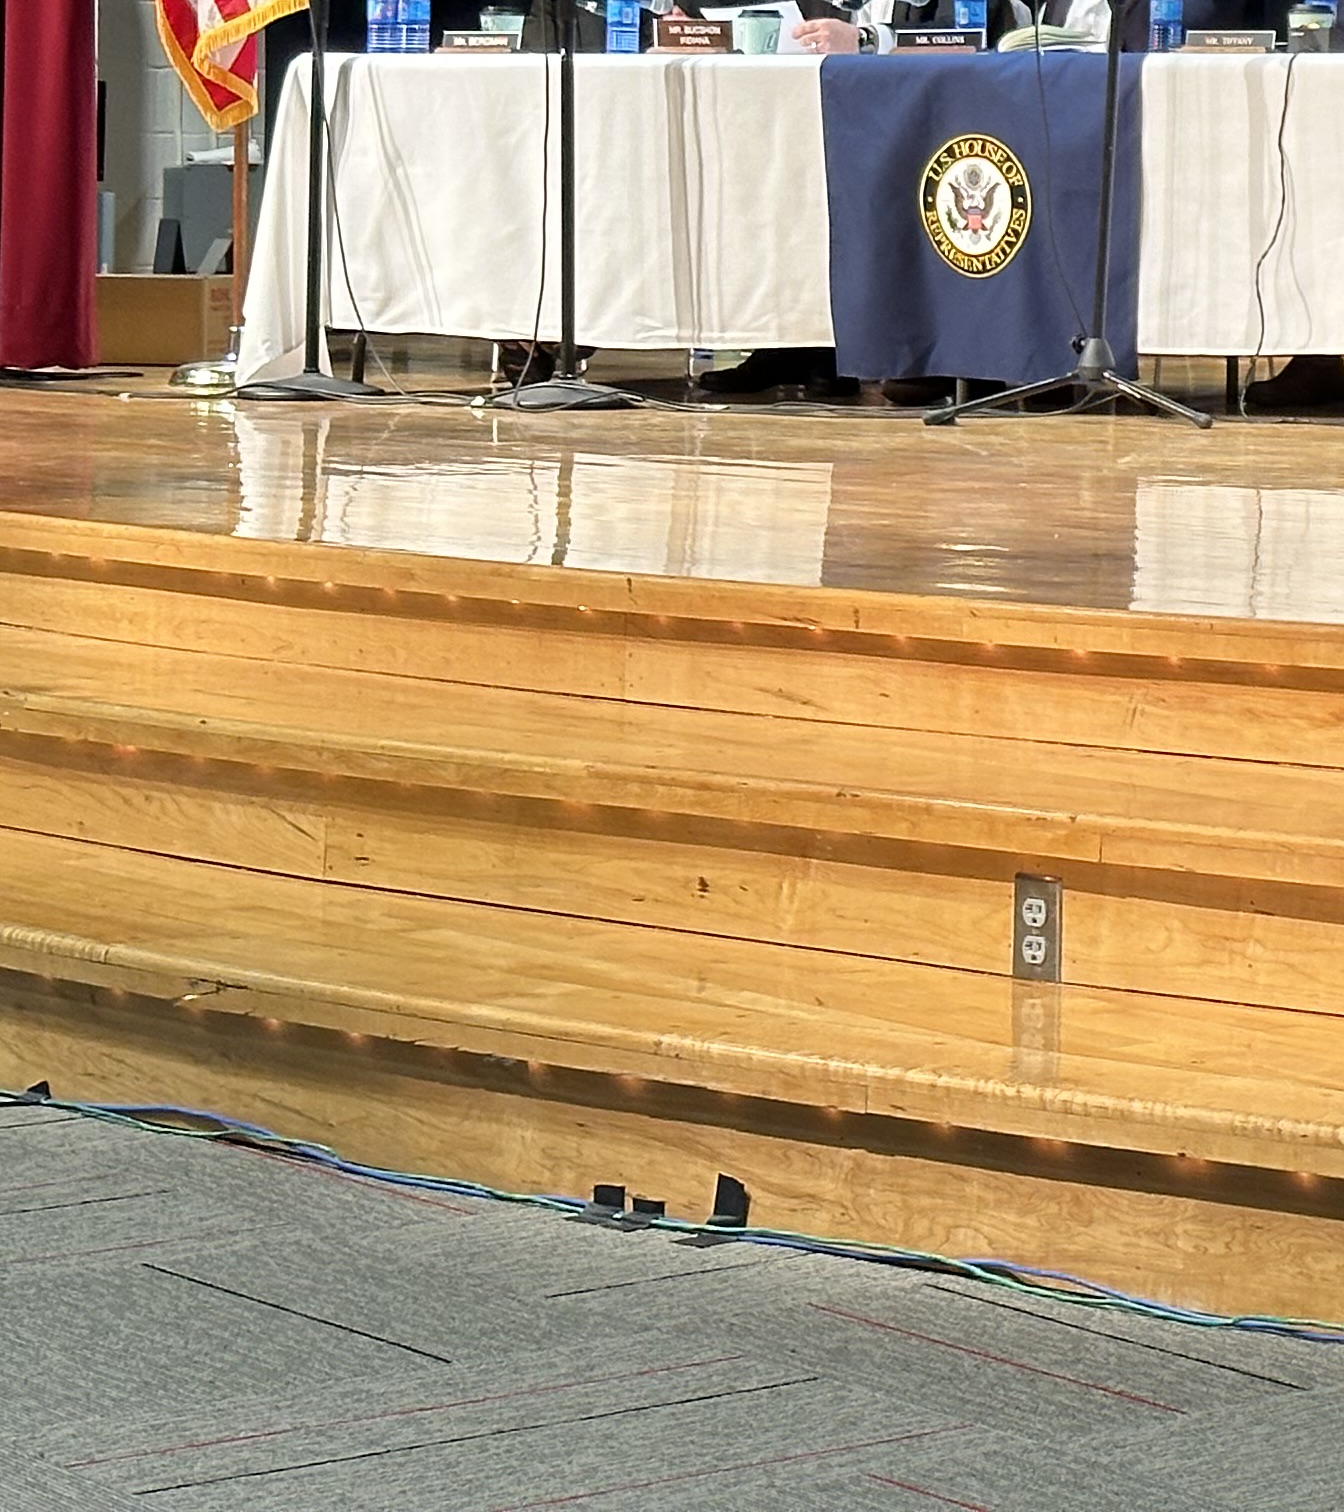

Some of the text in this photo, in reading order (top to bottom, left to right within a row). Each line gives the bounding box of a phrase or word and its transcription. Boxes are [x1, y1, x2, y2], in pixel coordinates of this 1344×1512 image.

[915, 35, 966, 44] MR. COLLINS
[928, 139, 1025, 187] U.S. HOUSE OF
[926, 207, 1027, 273] REPRESENTATIVES
